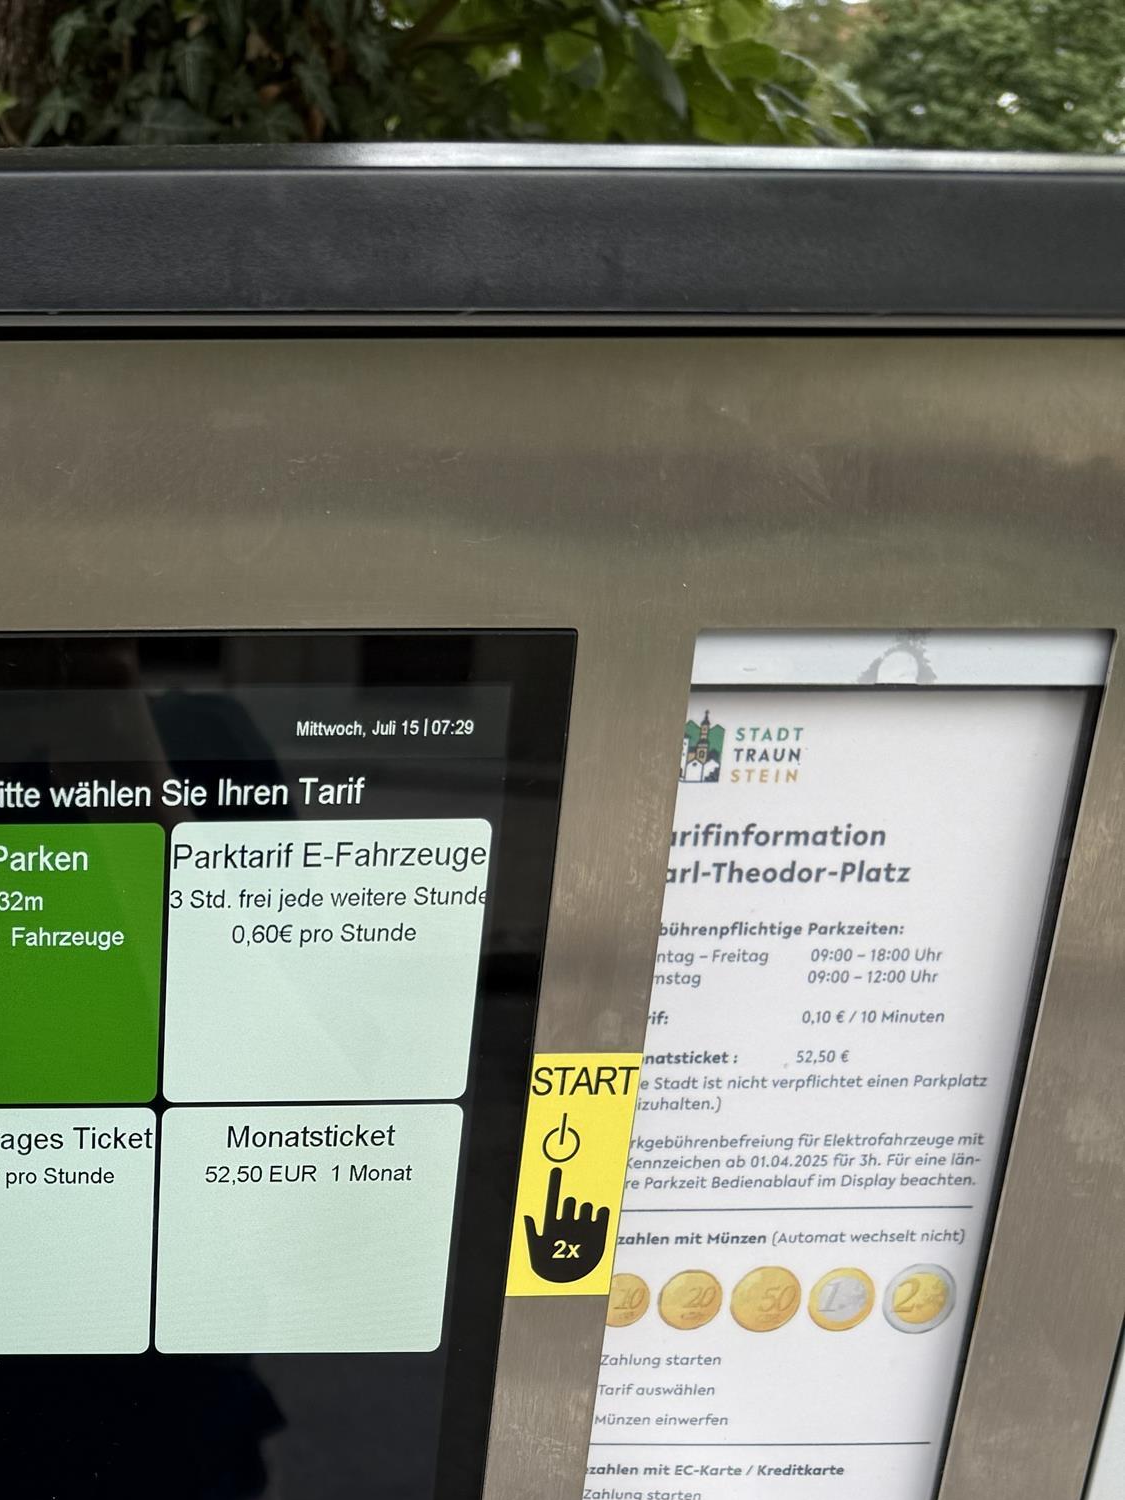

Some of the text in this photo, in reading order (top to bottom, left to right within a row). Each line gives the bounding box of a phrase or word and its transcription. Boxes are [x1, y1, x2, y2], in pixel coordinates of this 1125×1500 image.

[296, 719, 474, 737] Mittwoch, Juli 15 07:29
[735, 727, 804, 742] STADT
[734, 748, 801, 762] TRAUN
[731, 769, 799, 783] STEIN
[50, 781, 152, 808] wählen
[161, 779, 207, 807] Sie
[217, 778, 289, 805] Ihren
[299, 777, 365, 805] Tarif
[671, 824, 886, 847] rifinformation
[173, 842, 487, 873] Parktarif E-Fahrzeuge
[667, 861, 911, 884] arl-Theodor-Platz
[170, 890, 183, 909] 3
[191, 889, 232, 909] Std.
[239, 889, 272, 908] frei
[277, 888, 324, 914] jede
[330, 888, 407, 907] weitere
[11, 926, 125, 952] Fahrzeuge
[232, 923, 417, 949] 0,60€ pro Stunde
[659, 922, 904, 939] bührenpflichtige Parkzeiten:
[657, 948, 942, 966] ntag Freitag 09:00 18:00 Uhr
[807, 970, 938, 984] 09:00 12:00 Uhr
[802, 1010, 945, 1024] 0,10 10 Minuten
[643, 1050, 835, 1065] natsticket 52,50
[532, 1067, 639, 1096] START
[654, 1074, 987, 1091] Stadt ist nicht verpflichtet einen Parkplatz
[73, 1127, 154, 1149] Ticket
[226, 1125, 396, 1148] Monatsticket
[630, 1133, 984, 1151] rkgebührenbefreiung für Elektrofahrzeuge mit
[726, 1153, 981, 1168] ab 01.04.2025 für 3h. Für eine län-
[5, 1170, 39, 1190] pro
[44, 1166, 115, 1185] Stunde
[204, 1163, 412, 1186] 52,50 EUR Monat
[645, 1173, 976, 1189] Parkzeit Bedienablauf im Display beachten.
[618, 1228, 965, 1247] zahlen mit Münzen (Automat wechselt nicht)
[552, 1240, 581, 1259] 2x
[600, 1354, 721, 1368] Zahlung starten
[599, 1384, 715, 1397] Tarif auswählen
[595, 1414, 728, 1426] Münzen einwerfen
[587, 1465, 845, 1476] zahlen mit EC-Karte Kreditkarte
[647, 1490, 701, 1500] starten
